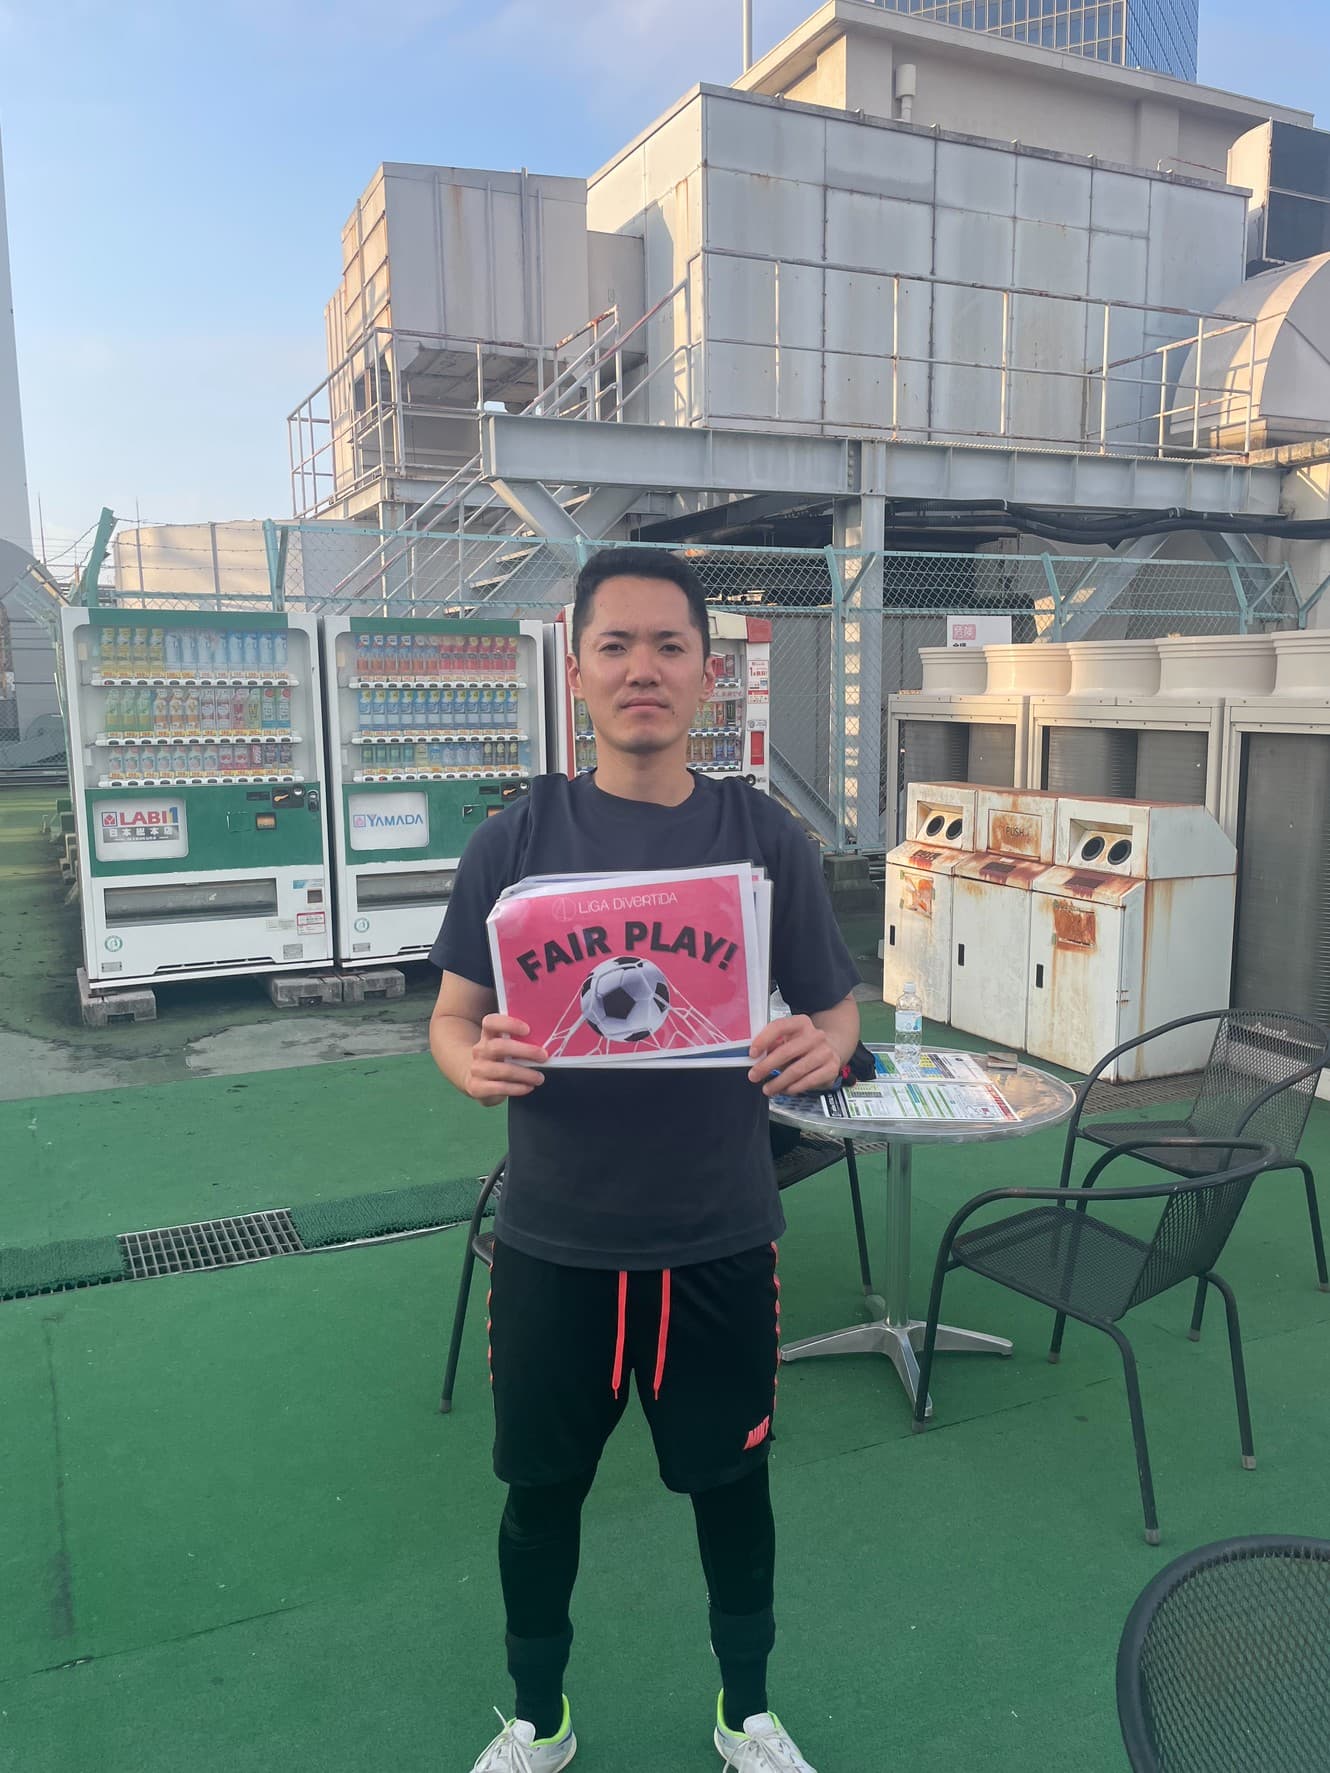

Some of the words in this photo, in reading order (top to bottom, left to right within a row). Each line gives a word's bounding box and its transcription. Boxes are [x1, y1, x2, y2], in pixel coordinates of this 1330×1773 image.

[366, 814, 424, 827] YAMADA
[516, 926, 612, 982] FAIR
[624, 921, 738, 971] PLAY!
